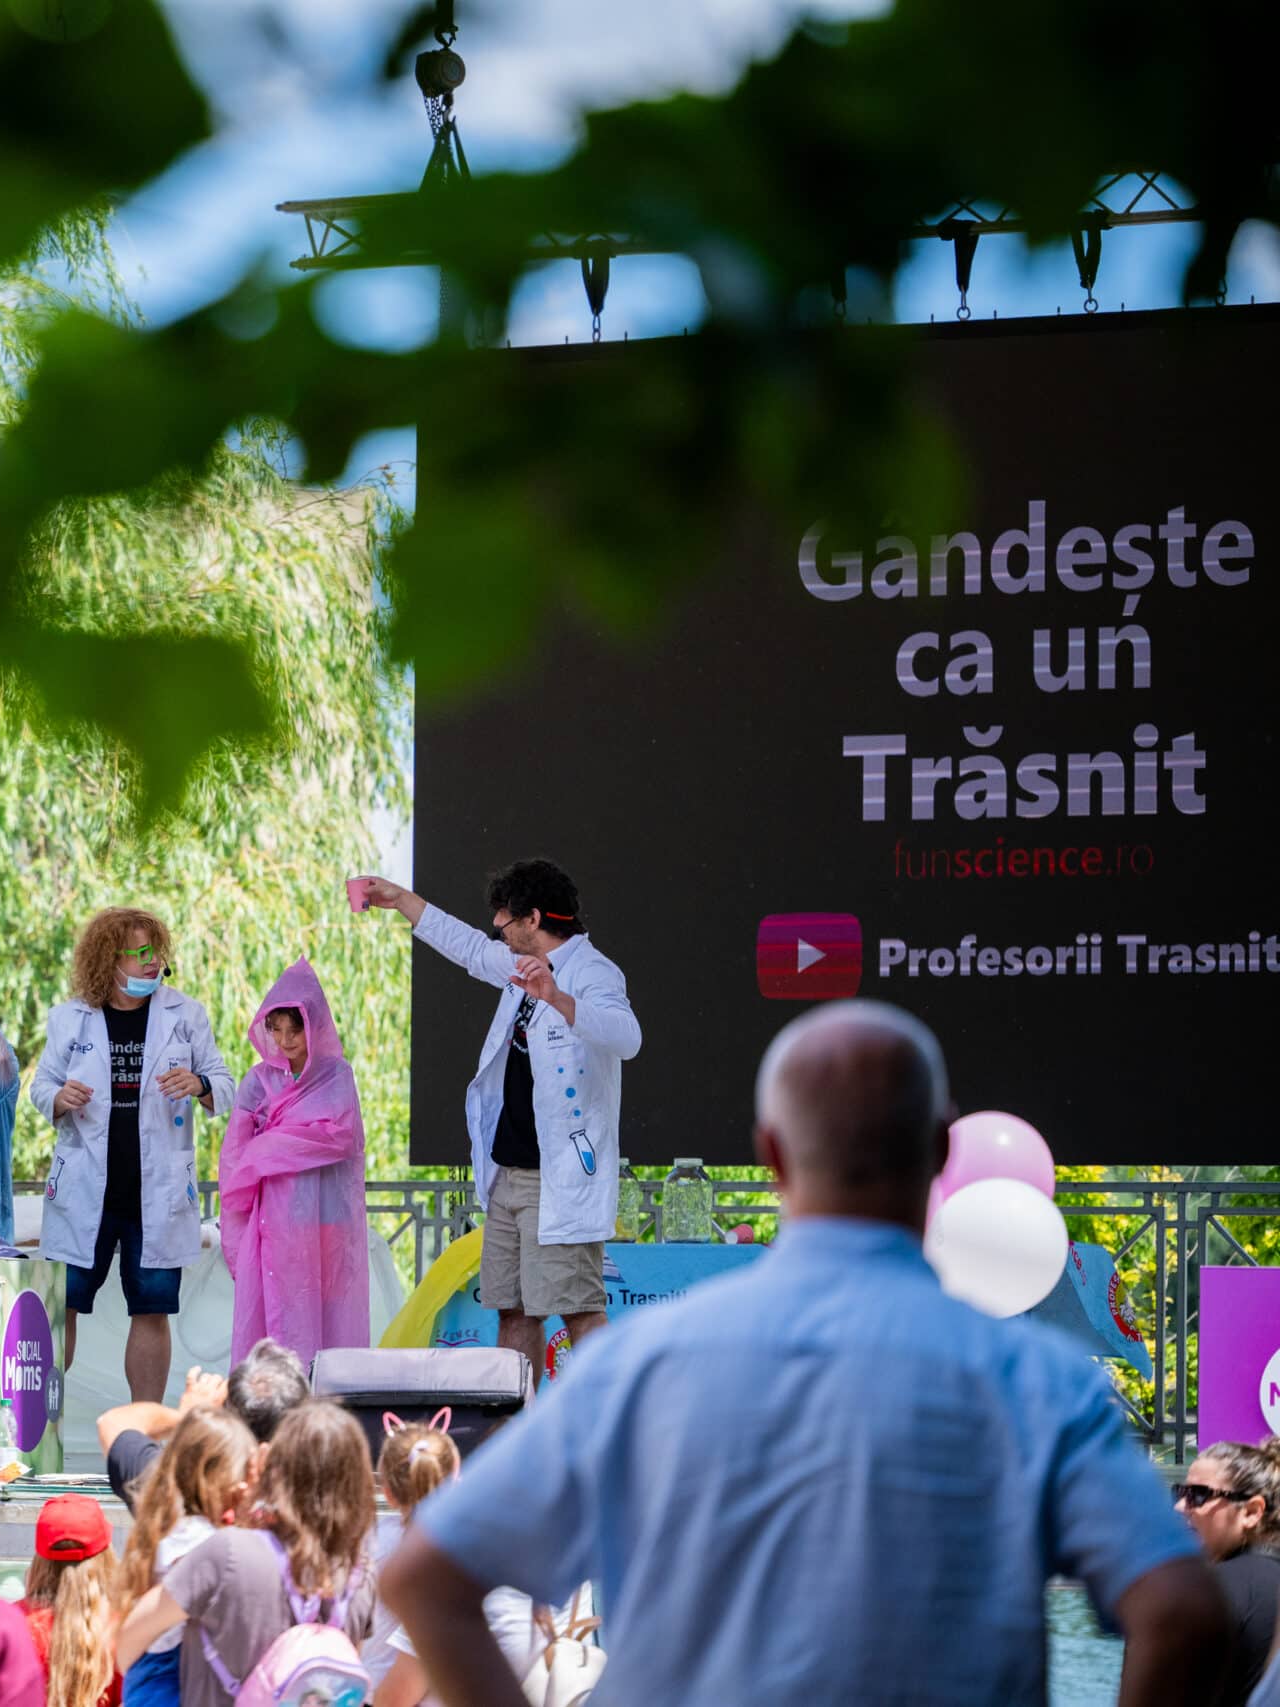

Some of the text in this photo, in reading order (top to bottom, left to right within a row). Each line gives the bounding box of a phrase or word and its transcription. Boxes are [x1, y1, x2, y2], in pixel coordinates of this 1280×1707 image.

[895, 630, 994, 696] ca
[842, 723, 1207, 822] Trăsnit
[894, 837, 1155, 879] funscience.ro
[878, 933, 1103, 977] Profesorii
[16, 1340, 43, 1362] SOCIAL
[4, 1355, 43, 1392] Moms
